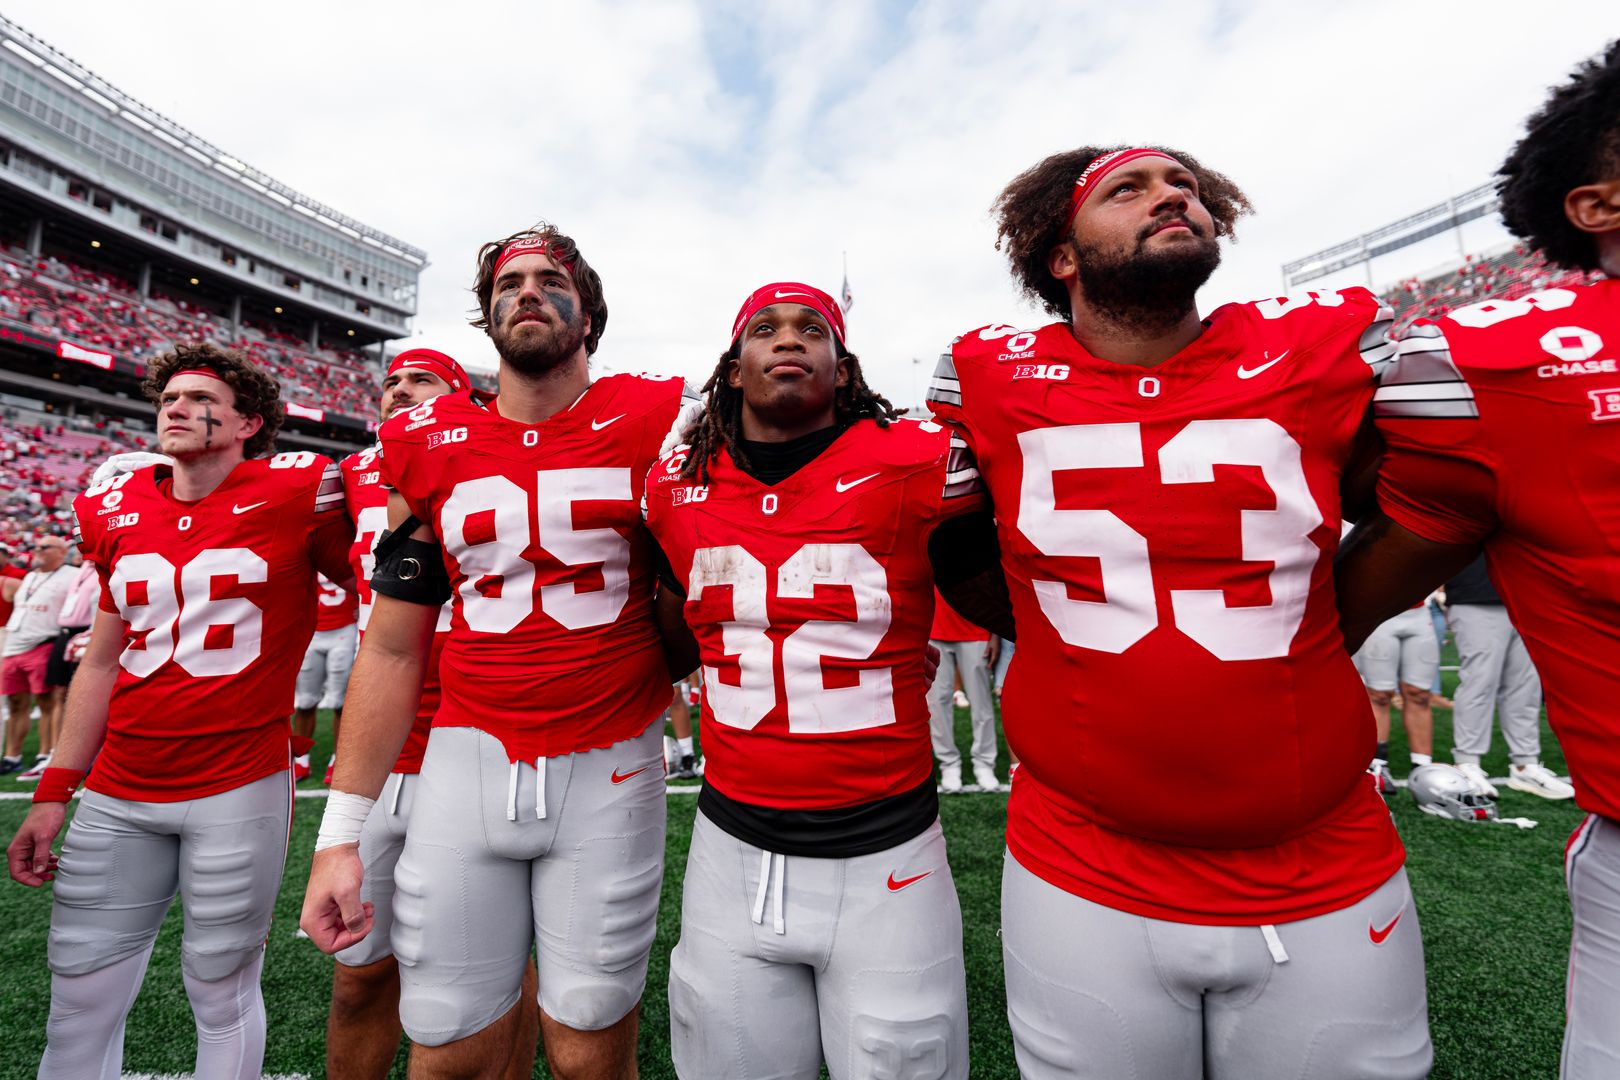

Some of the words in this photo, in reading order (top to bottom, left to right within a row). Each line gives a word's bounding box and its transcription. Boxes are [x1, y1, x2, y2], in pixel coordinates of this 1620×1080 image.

[998, 351, 1035, 361] CHASE
[1537, 359, 1618, 378] CHASE
[405, 417, 437, 432] CHASE
[658, 473, 681, 483] CHAS
[441, 467, 634, 634] 85
[1017, 418, 1323, 661] 53
[109, 547, 268, 679] 96
[686, 543, 897, 734] 32
